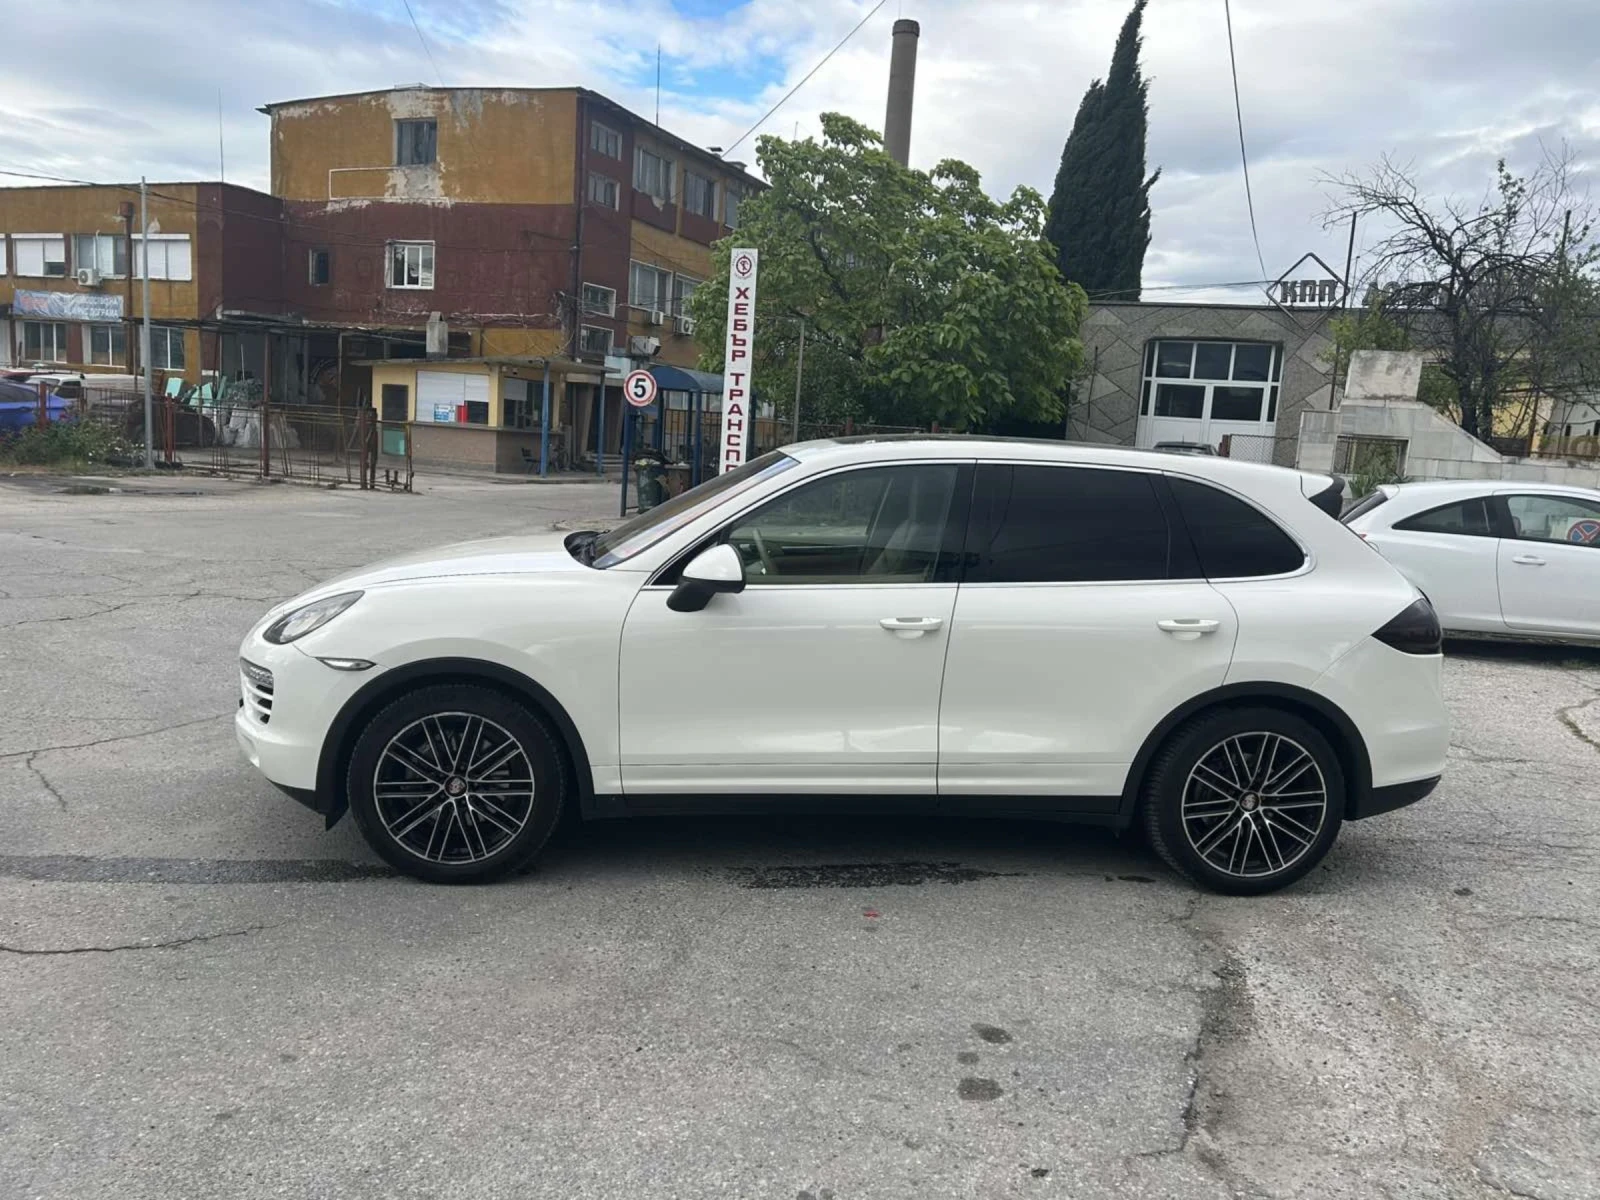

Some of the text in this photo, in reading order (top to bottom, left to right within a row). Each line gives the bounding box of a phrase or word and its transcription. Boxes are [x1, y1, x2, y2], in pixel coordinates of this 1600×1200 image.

[1280, 279, 1337, 303] КПП
[731, 287, 750, 362] ХЕБЪР
[633, 377, 647, 398] 5
